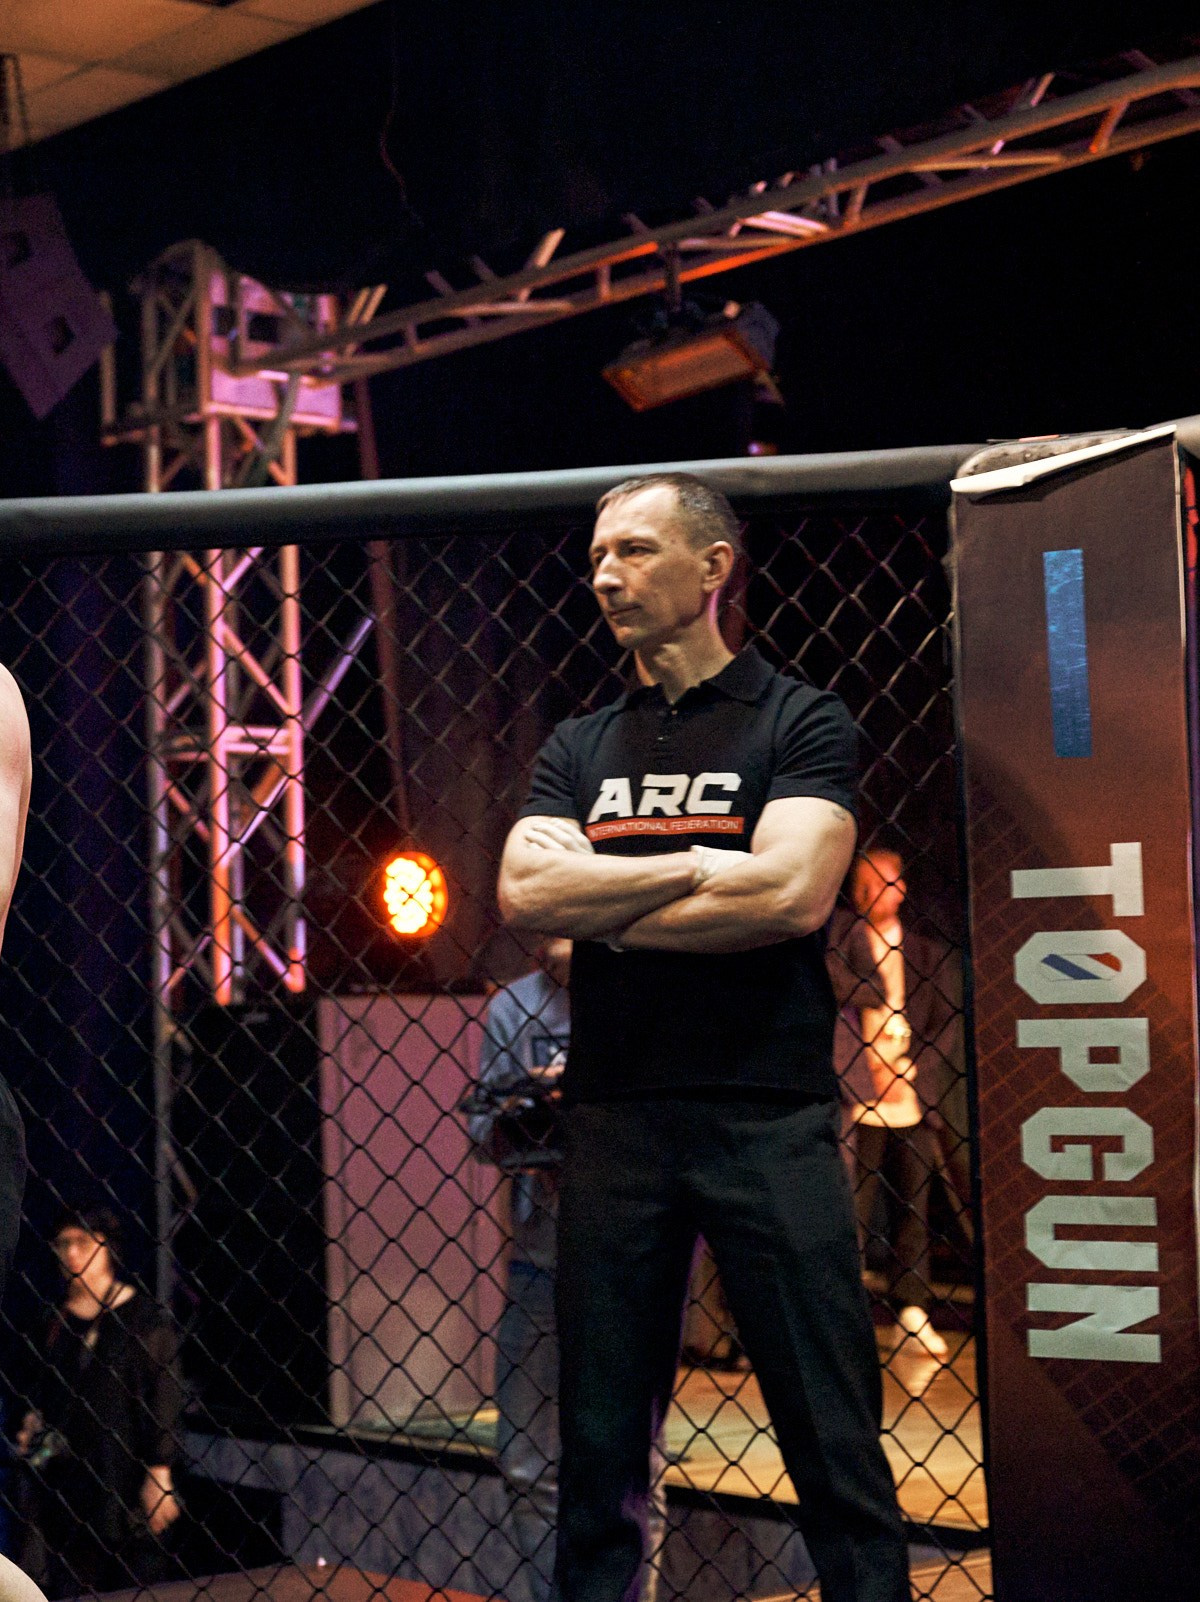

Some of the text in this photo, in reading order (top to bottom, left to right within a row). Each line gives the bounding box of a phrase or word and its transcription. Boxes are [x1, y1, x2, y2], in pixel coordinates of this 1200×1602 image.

[586, 772, 742, 825] ARC
[669, 819, 739, 832] FEDERATION
[1011, 840, 1162, 1363] TOPGUN
